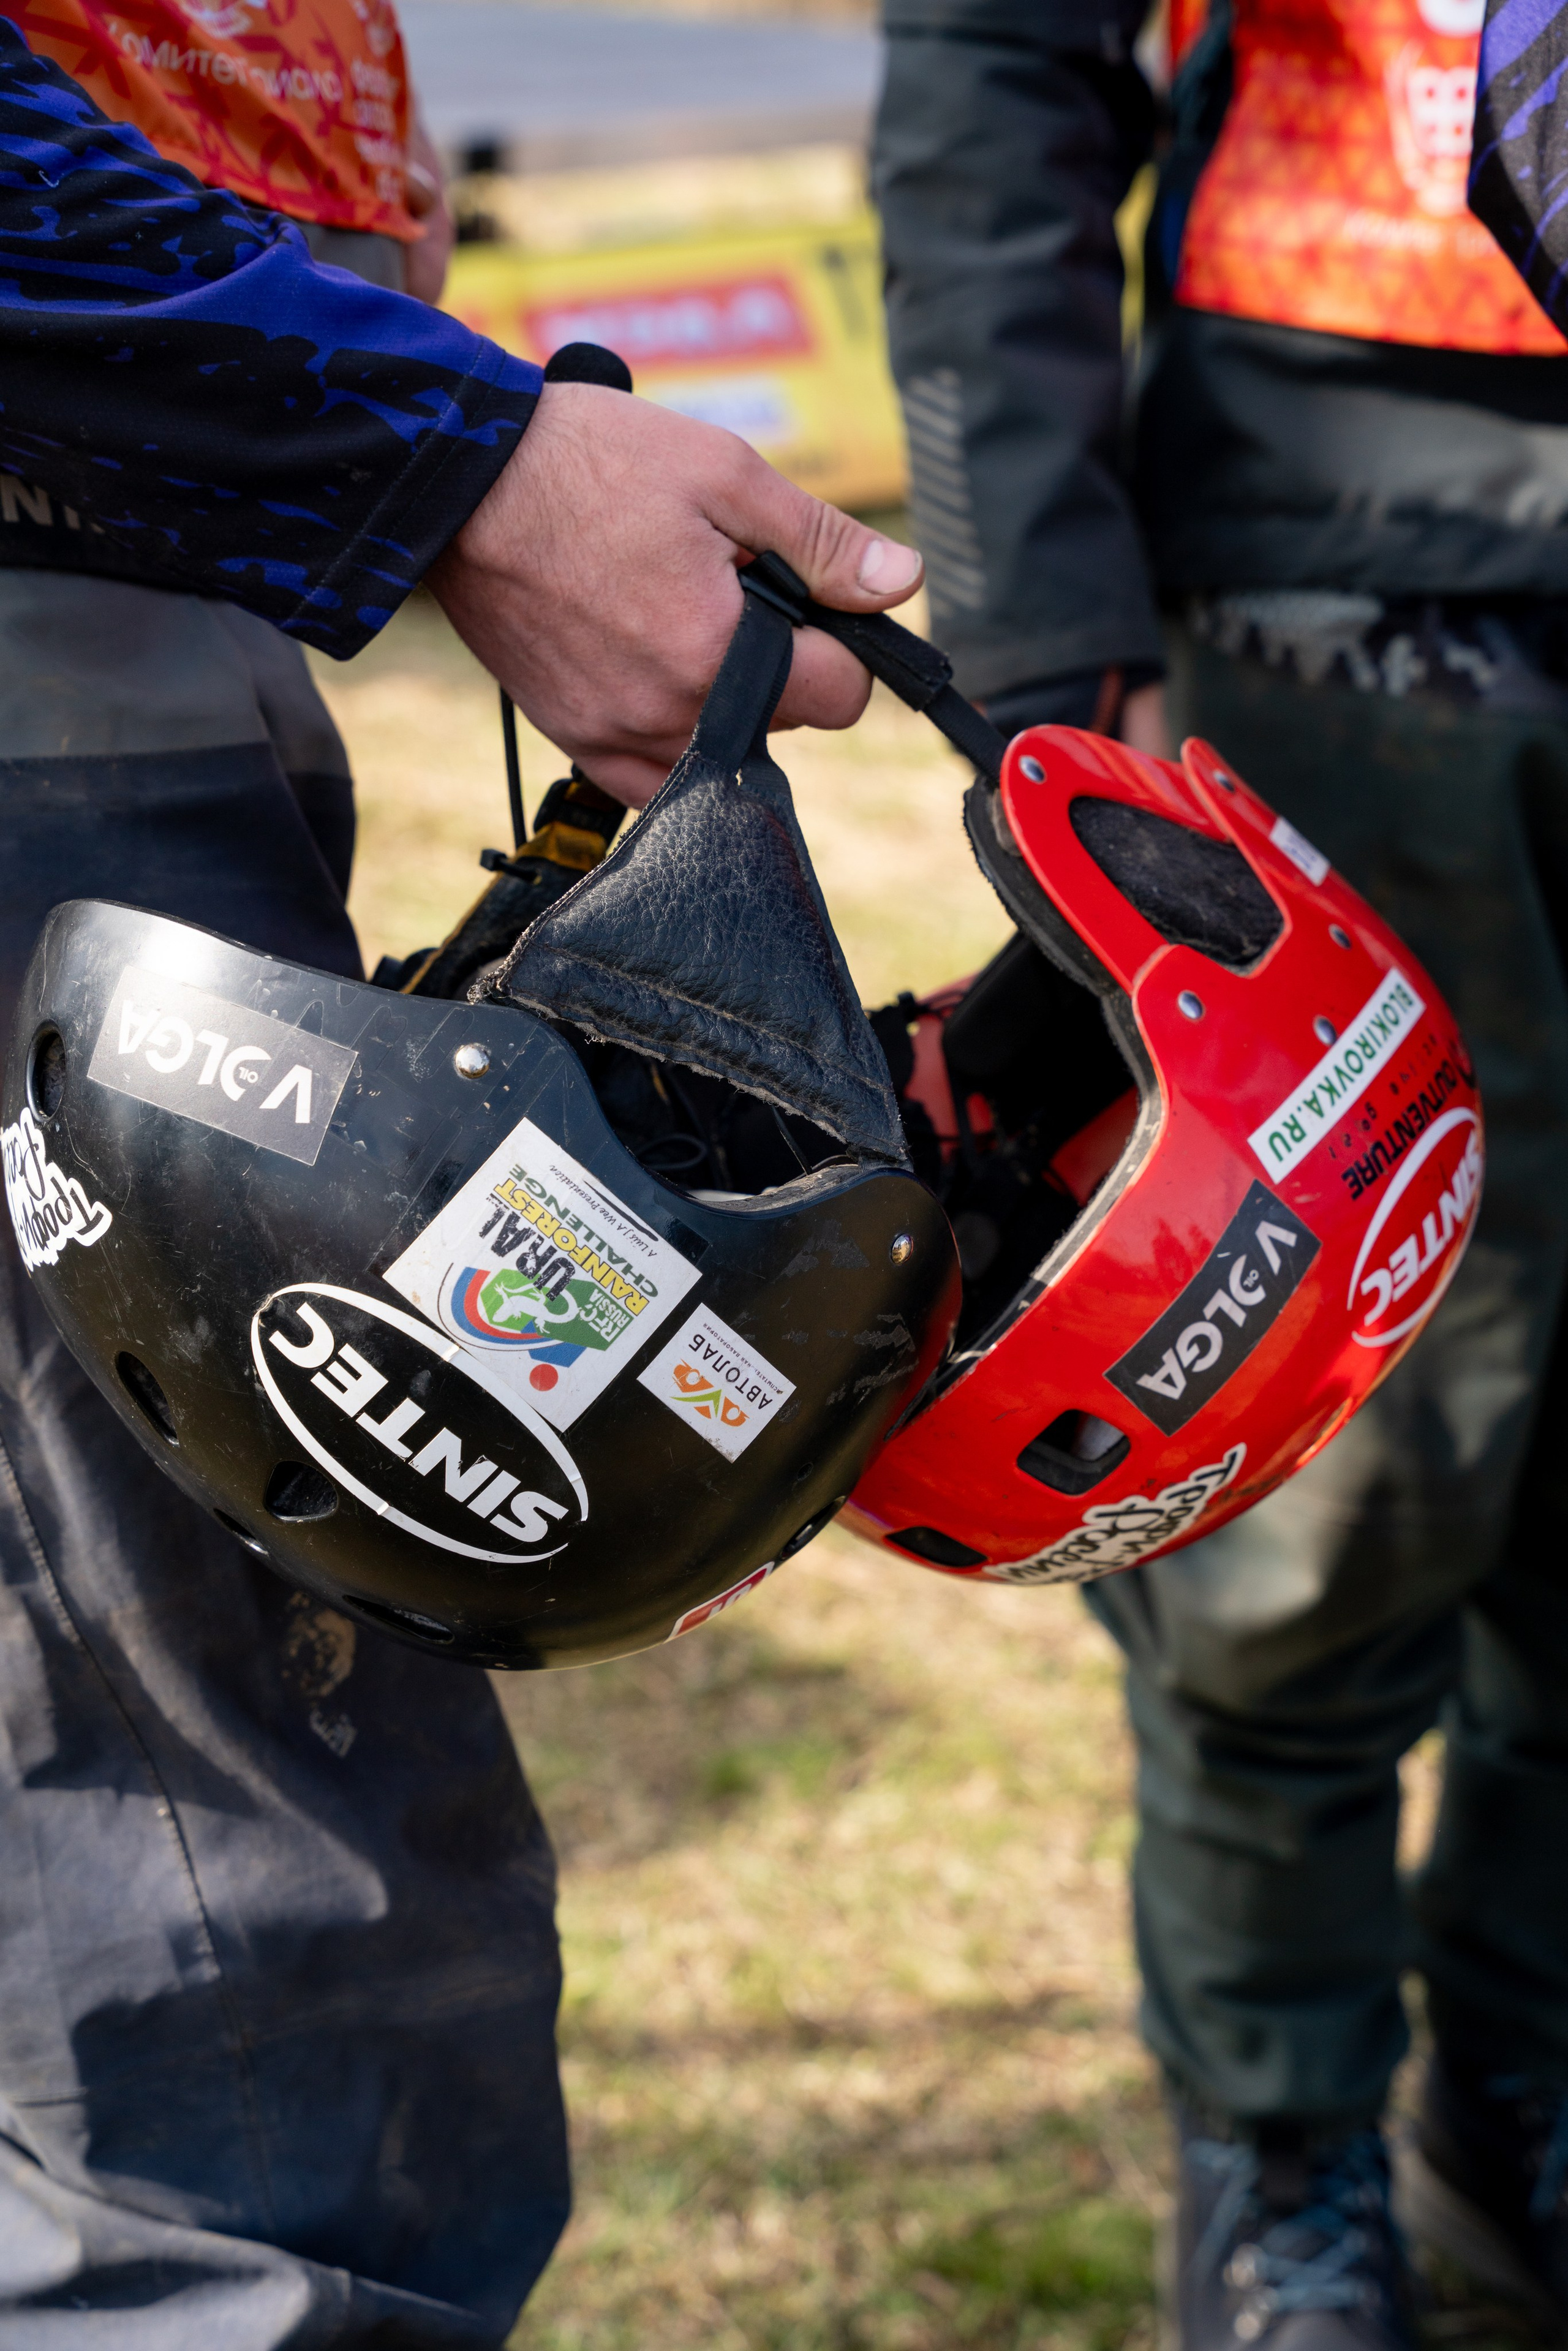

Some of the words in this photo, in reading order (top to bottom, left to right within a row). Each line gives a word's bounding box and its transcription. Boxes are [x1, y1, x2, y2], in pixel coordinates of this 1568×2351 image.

[118, 1000, 312, 1124] VOLGA
[238, 1066, 258, 1084] OIL
[1267, 983, 1414, 1163] BLOKIROVKA.RU
[1341, 1059, 1457, 1201] OUTVENTURE
[508, 1163, 658, 1298] CHALLENGE
[548, 1164, 600, 1210] Presentation
[599, 1207, 616, 1225] Wee
[1360, 1126, 1481, 1327] SINTEC
[478, 1193, 576, 1302] URAL
[493, 1177, 650, 1316] RAINFOREST
[1243, 1269, 1259, 1288] OIL
[579, 1304, 621, 1343] RFC
[589, 1288, 630, 1329] RUSSIA
[703, 1323, 741, 1358] ЛАБОРАТОРИЯ
[1136, 1220, 1297, 1400] VOLGA
[269, 1302, 569, 1542] SINTEC
[688, 1334, 773, 1410] АВТОЛАБ
